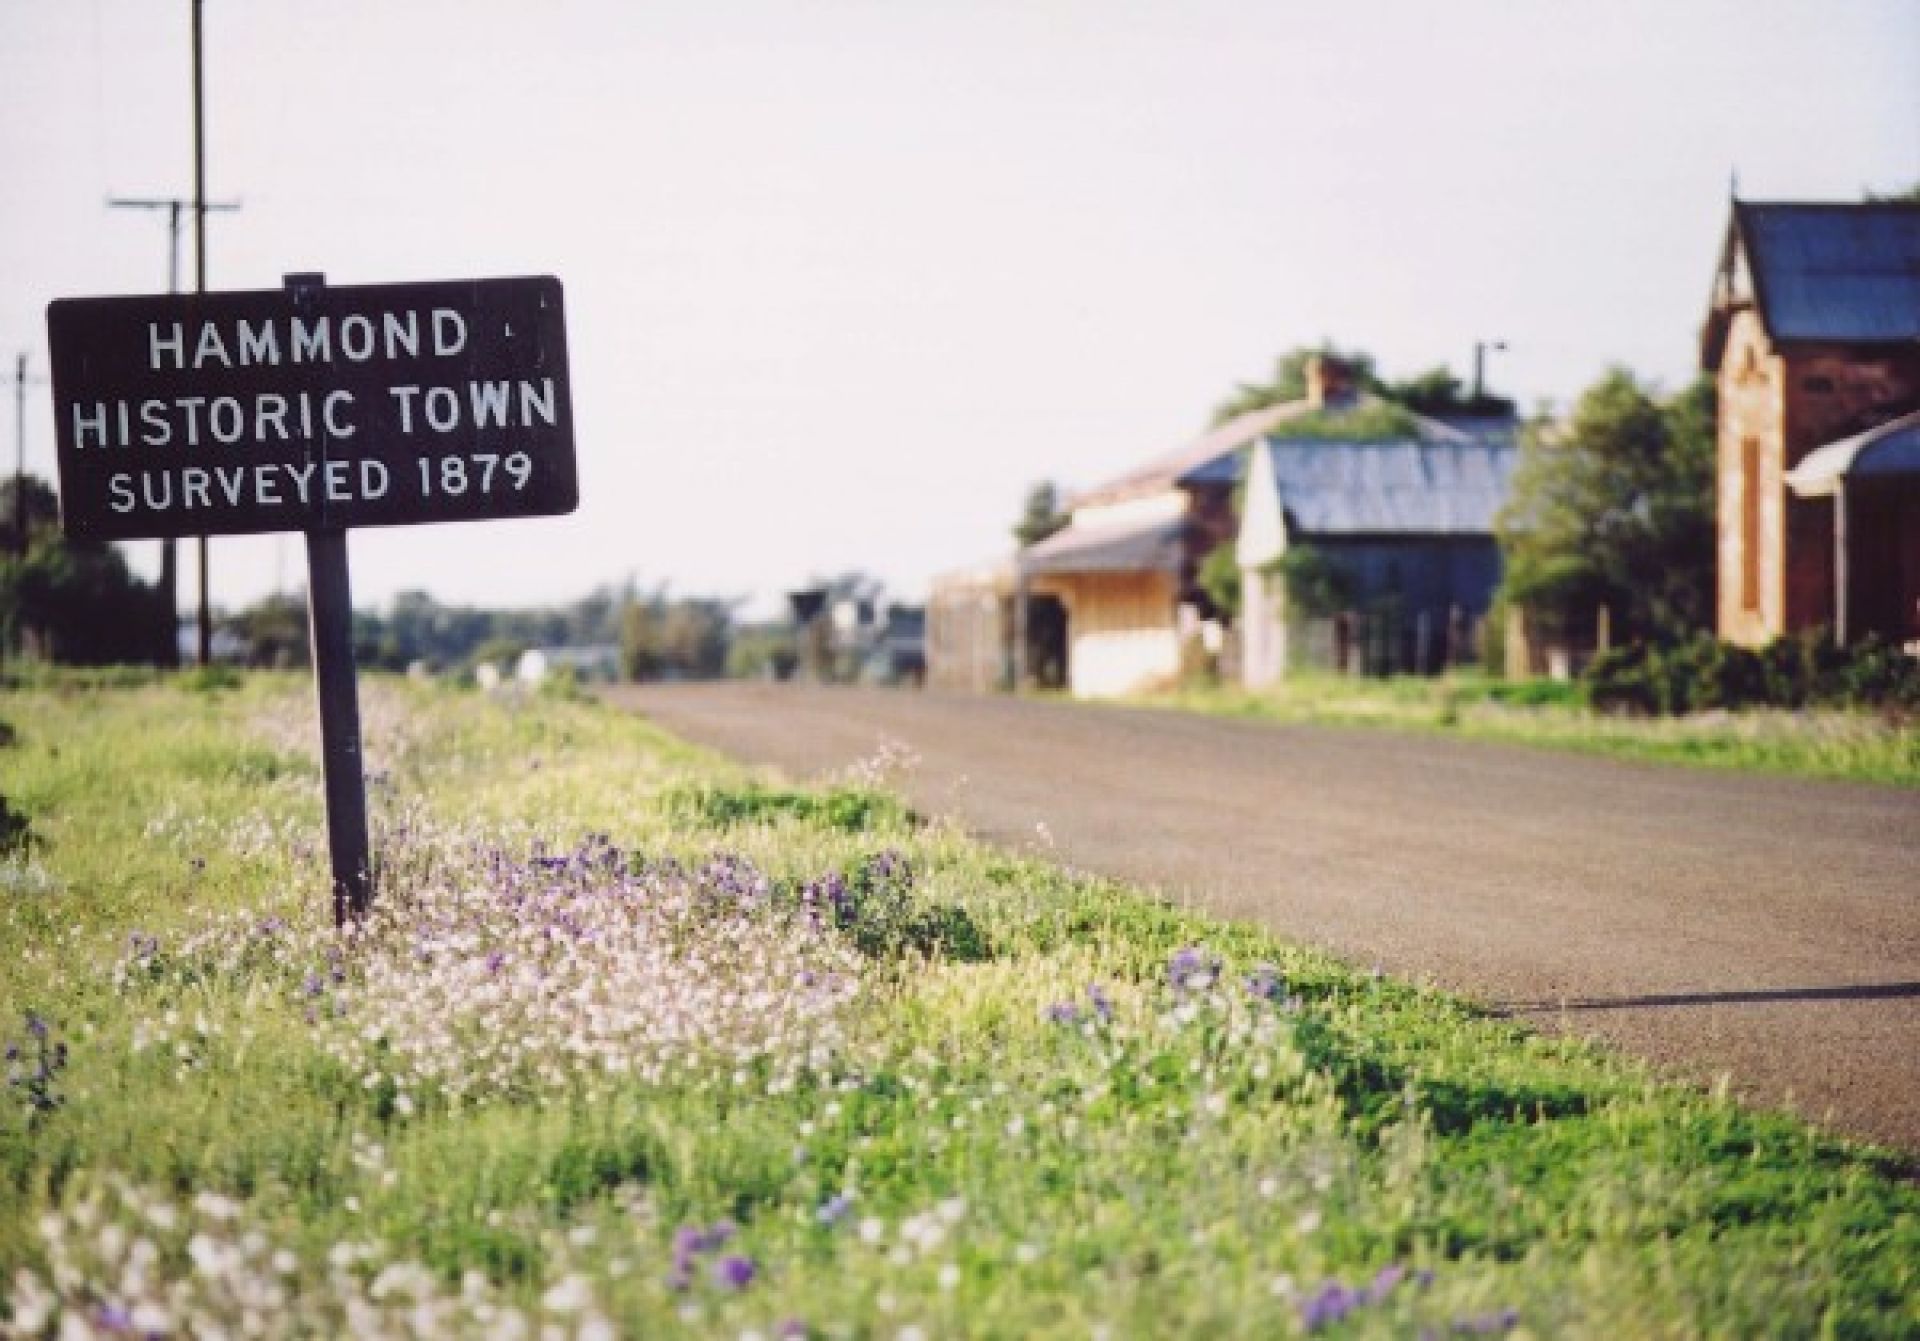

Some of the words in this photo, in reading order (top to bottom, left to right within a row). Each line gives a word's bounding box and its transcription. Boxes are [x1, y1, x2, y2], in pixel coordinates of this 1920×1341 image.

[149, 309, 468, 369] HAMMOND
[73, 389, 356, 449] HISTORIC
[389, 377, 556, 437] TOWN
[110, 459, 388, 513] SURVEYED
[418, 451, 532, 495] 1879
